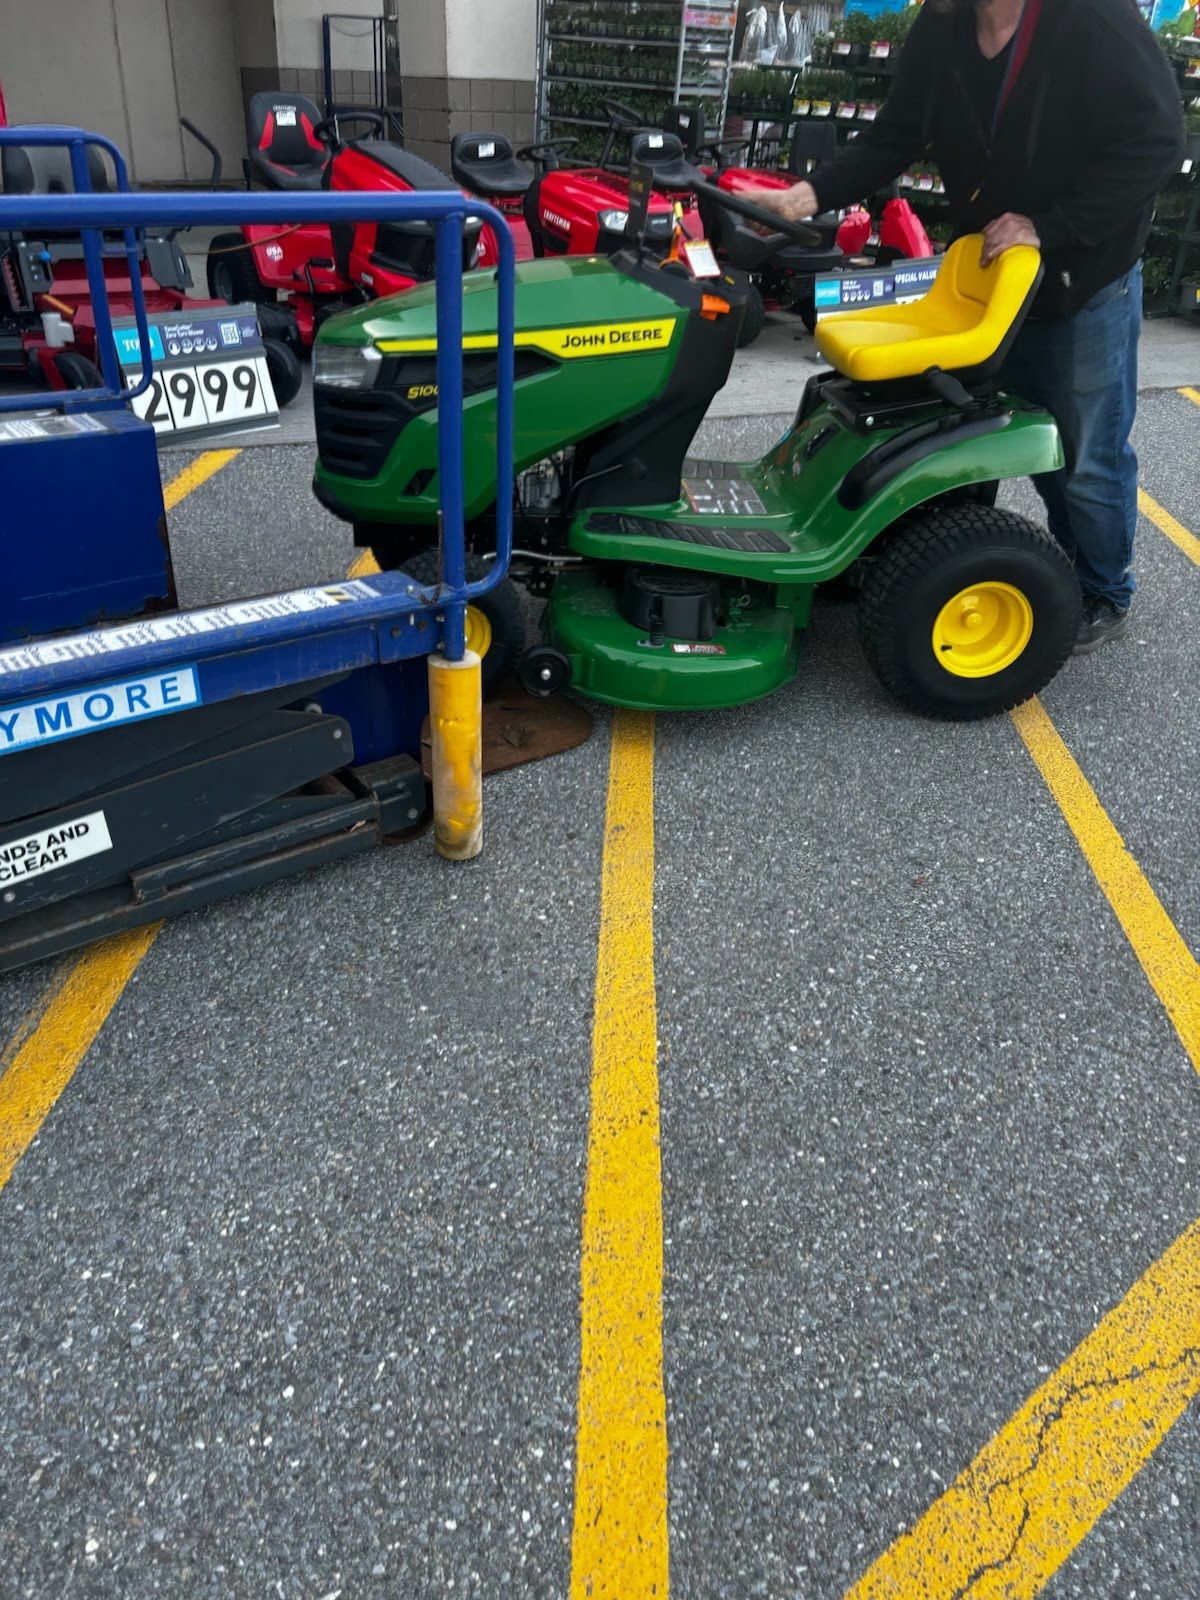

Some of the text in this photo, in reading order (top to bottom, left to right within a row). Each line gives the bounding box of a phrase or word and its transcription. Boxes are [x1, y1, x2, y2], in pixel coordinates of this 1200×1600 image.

[543, 209, 571, 231] CRAFTSMAN
[561, 328, 663, 348] JOHN DEERE
[47, 822, 90, 849] AND
[0, 847, 68, 881] CLEAR
